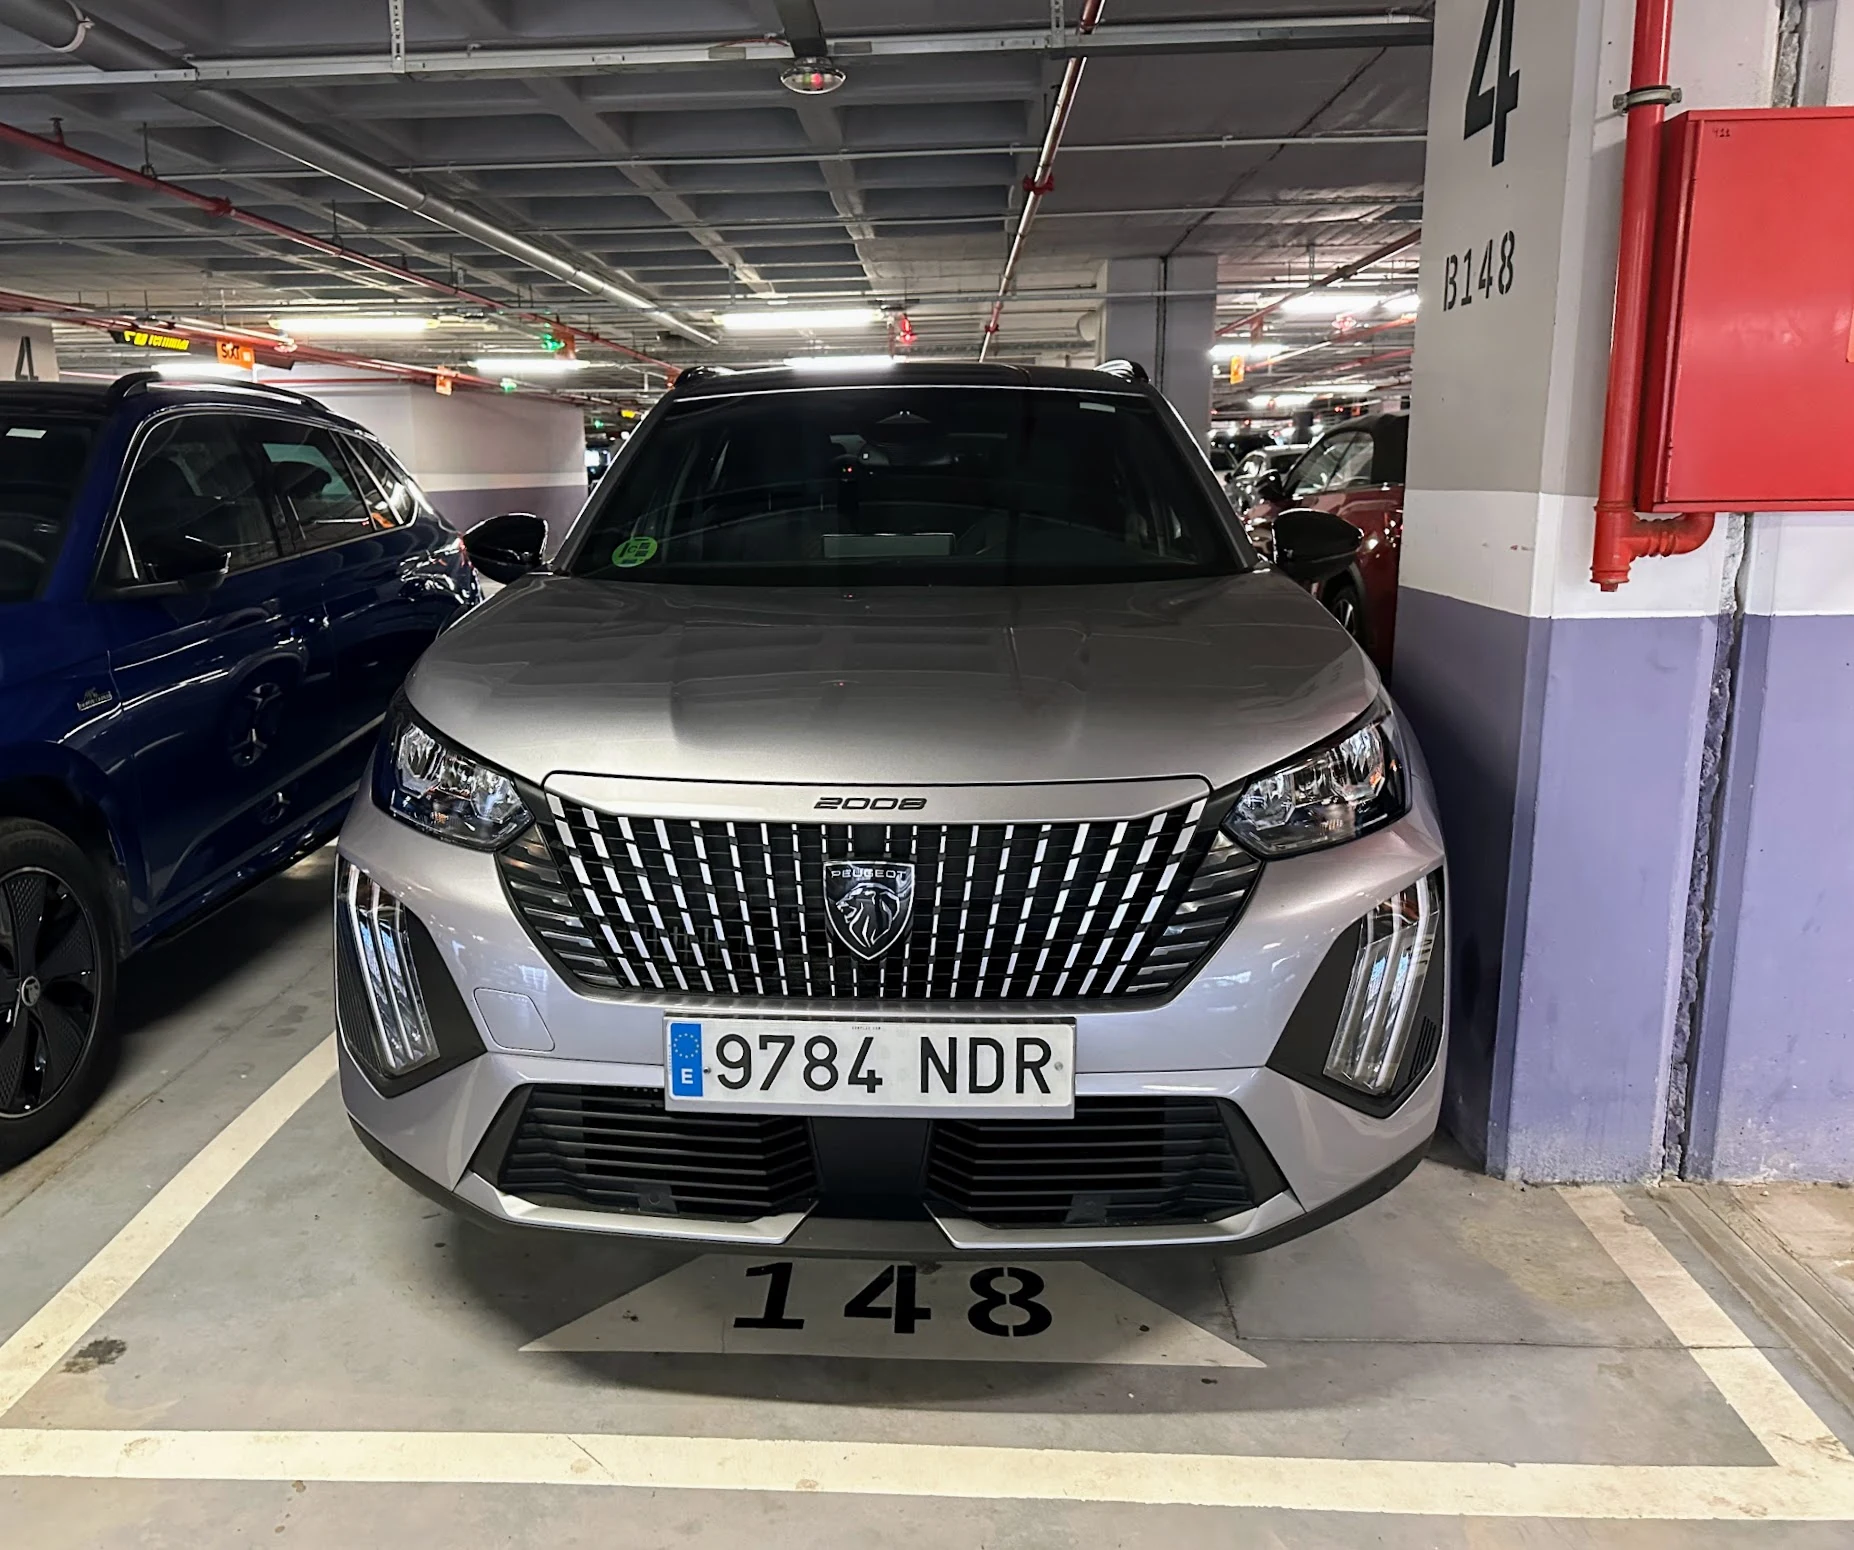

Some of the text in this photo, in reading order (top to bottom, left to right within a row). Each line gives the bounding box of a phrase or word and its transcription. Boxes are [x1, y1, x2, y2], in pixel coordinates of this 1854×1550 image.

[1463, 0, 1520, 167] 4
[1443, 230, 1515, 312] B148
[813, 797, 927, 810] 2008
[831, 869, 907, 879] PEUGEOT
[681, 1068, 694, 1084] E
[715, 1033, 884, 1094] 9784
[920, 1036, 1052, 1094] NDR
[733, 1262, 1052, 1337] 148
